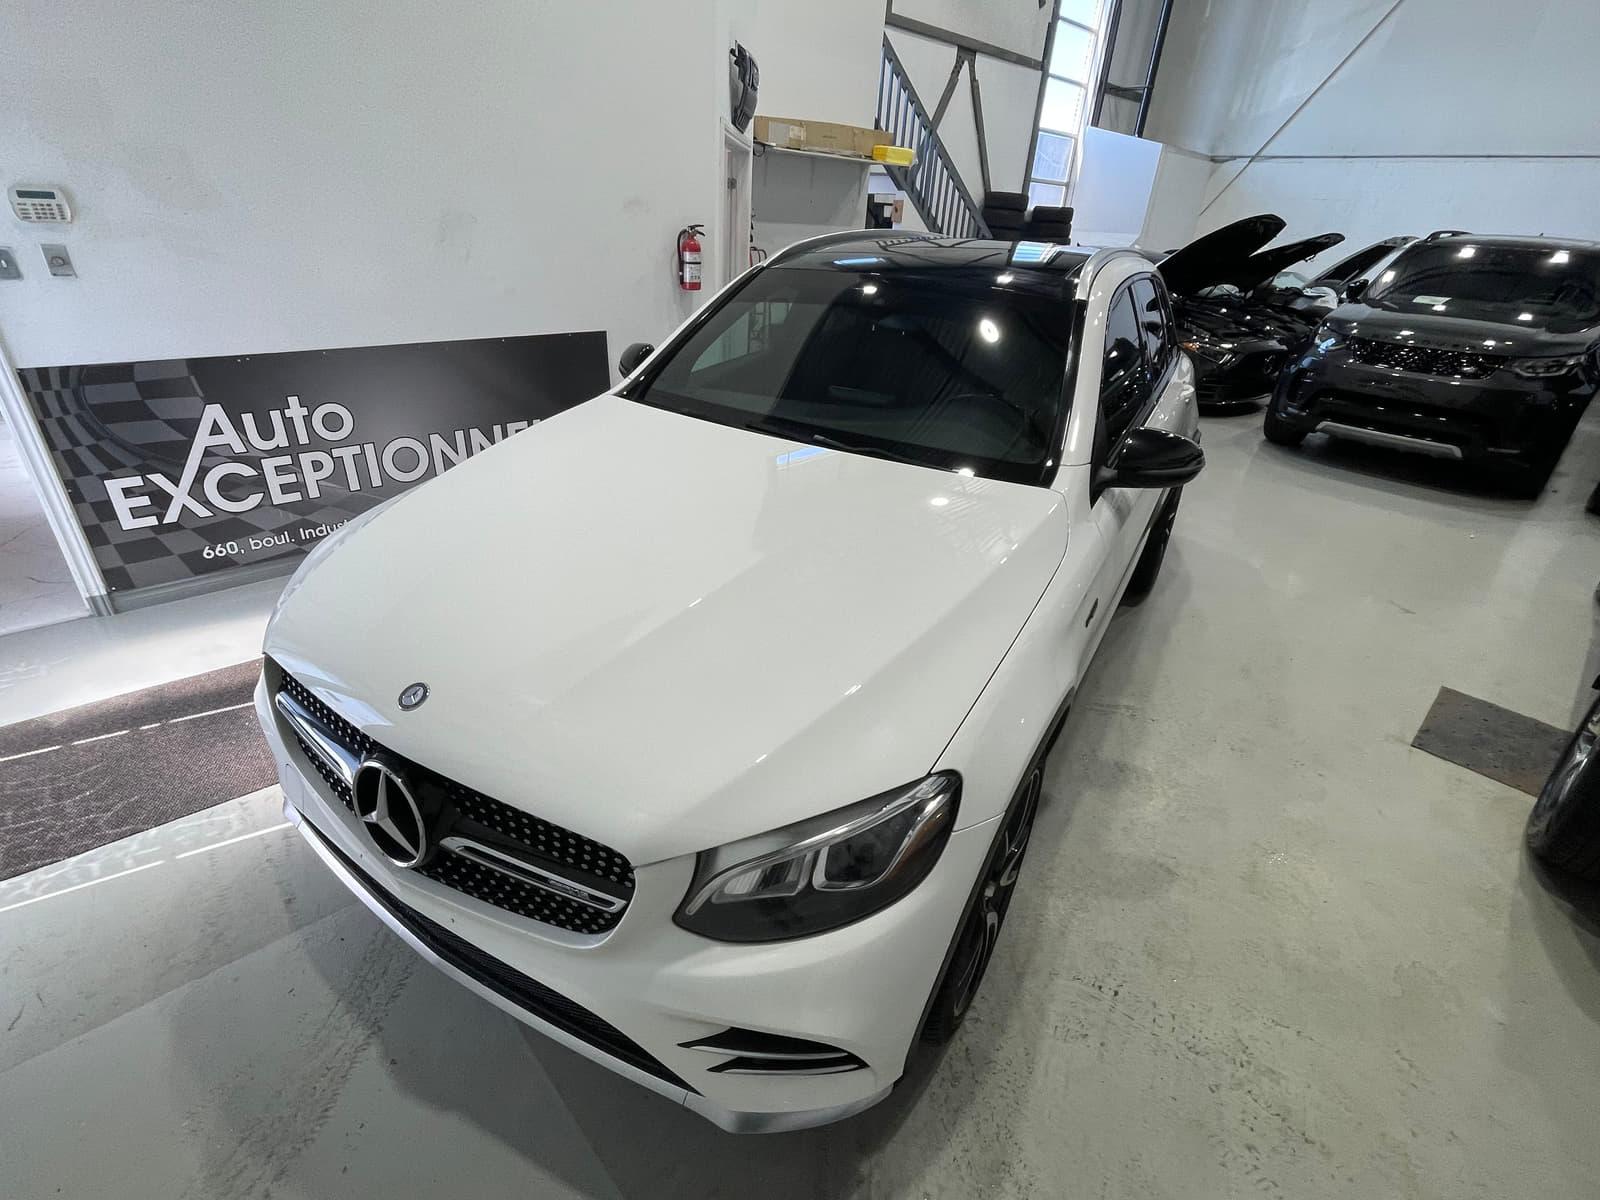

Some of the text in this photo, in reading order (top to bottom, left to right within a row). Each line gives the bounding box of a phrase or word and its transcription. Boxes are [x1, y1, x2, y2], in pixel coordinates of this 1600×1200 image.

[186, 396, 355, 458] Auto
[202, 541, 245, 559] 660,
[249, 531, 295, 551] boul.
